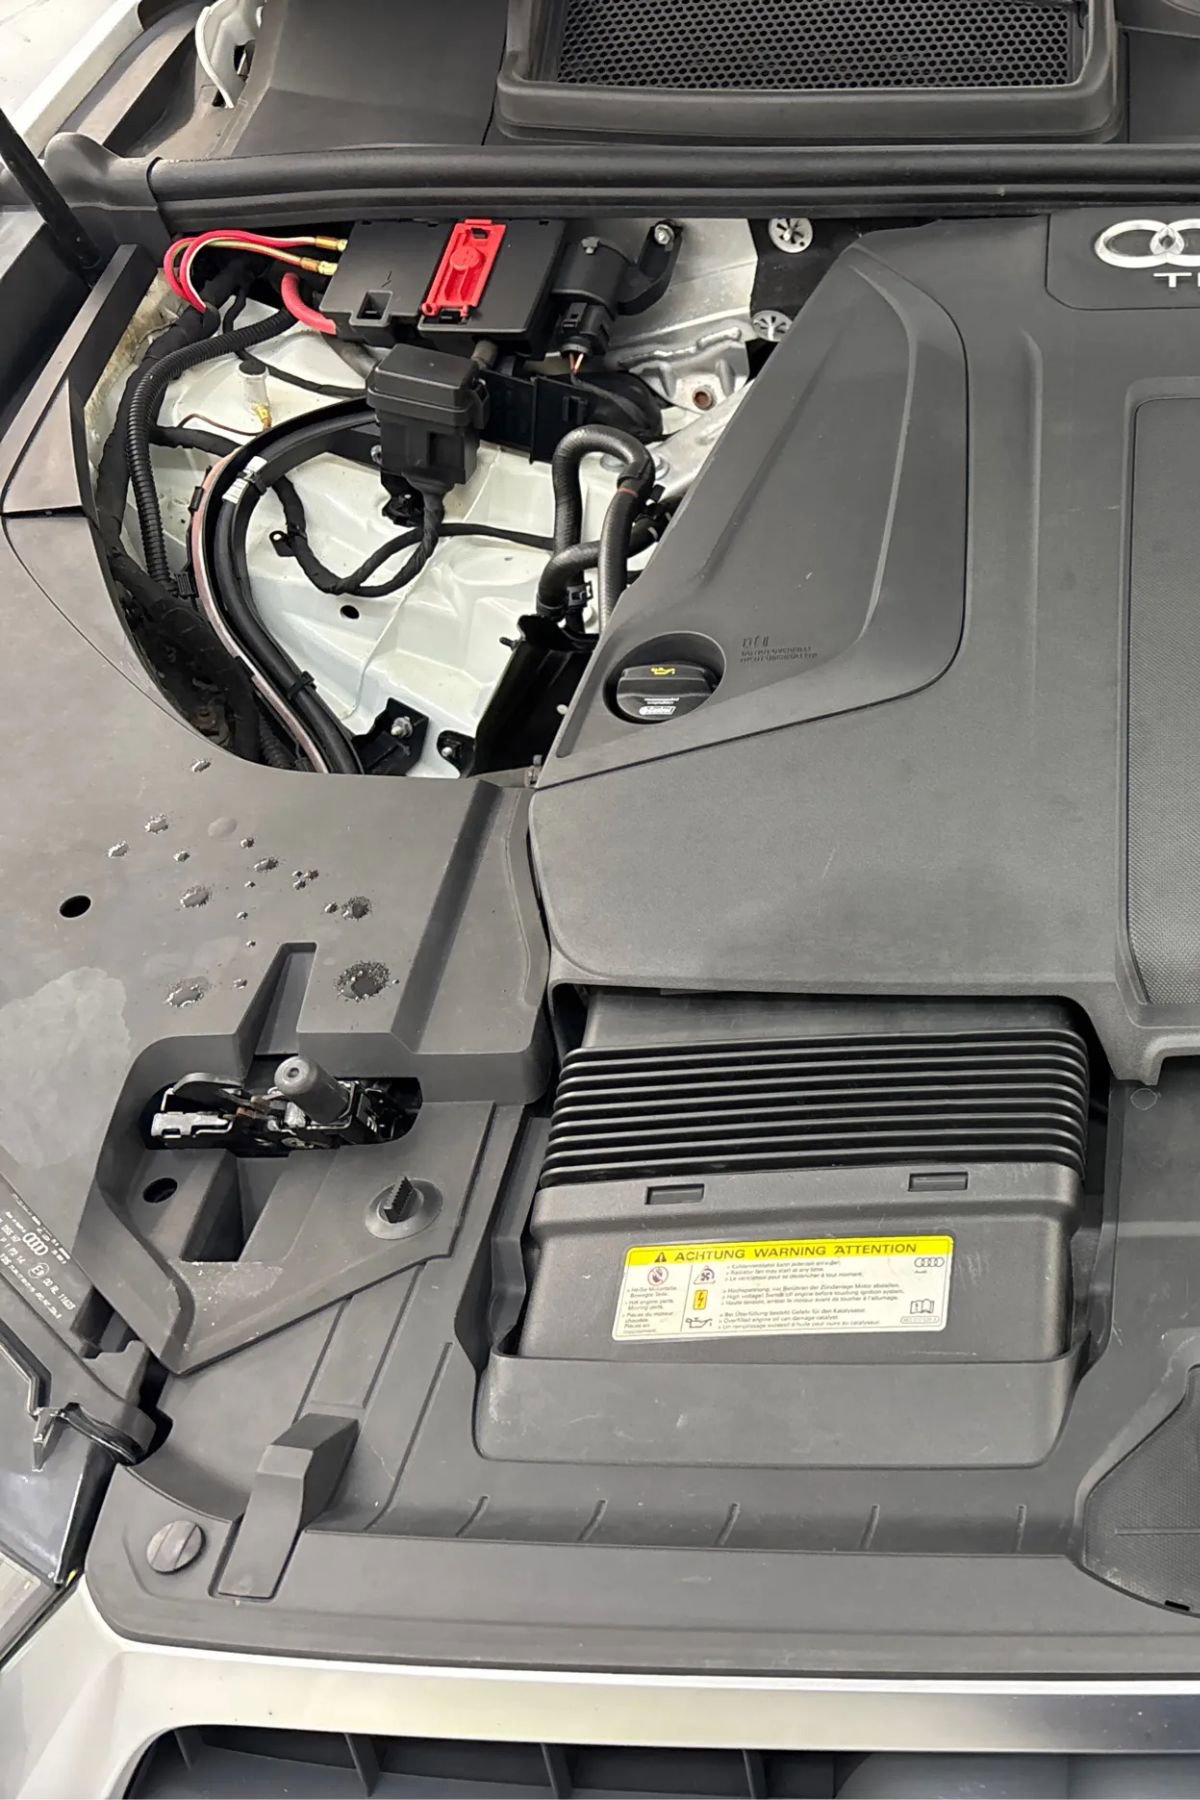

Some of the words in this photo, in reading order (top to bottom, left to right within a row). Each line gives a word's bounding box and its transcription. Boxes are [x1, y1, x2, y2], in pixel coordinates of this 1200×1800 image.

[674, 1249, 745, 1260] ACHTUNG
[753, 1246, 826, 1257] WARNING
[834, 1244, 917, 1255] ATTENTION
